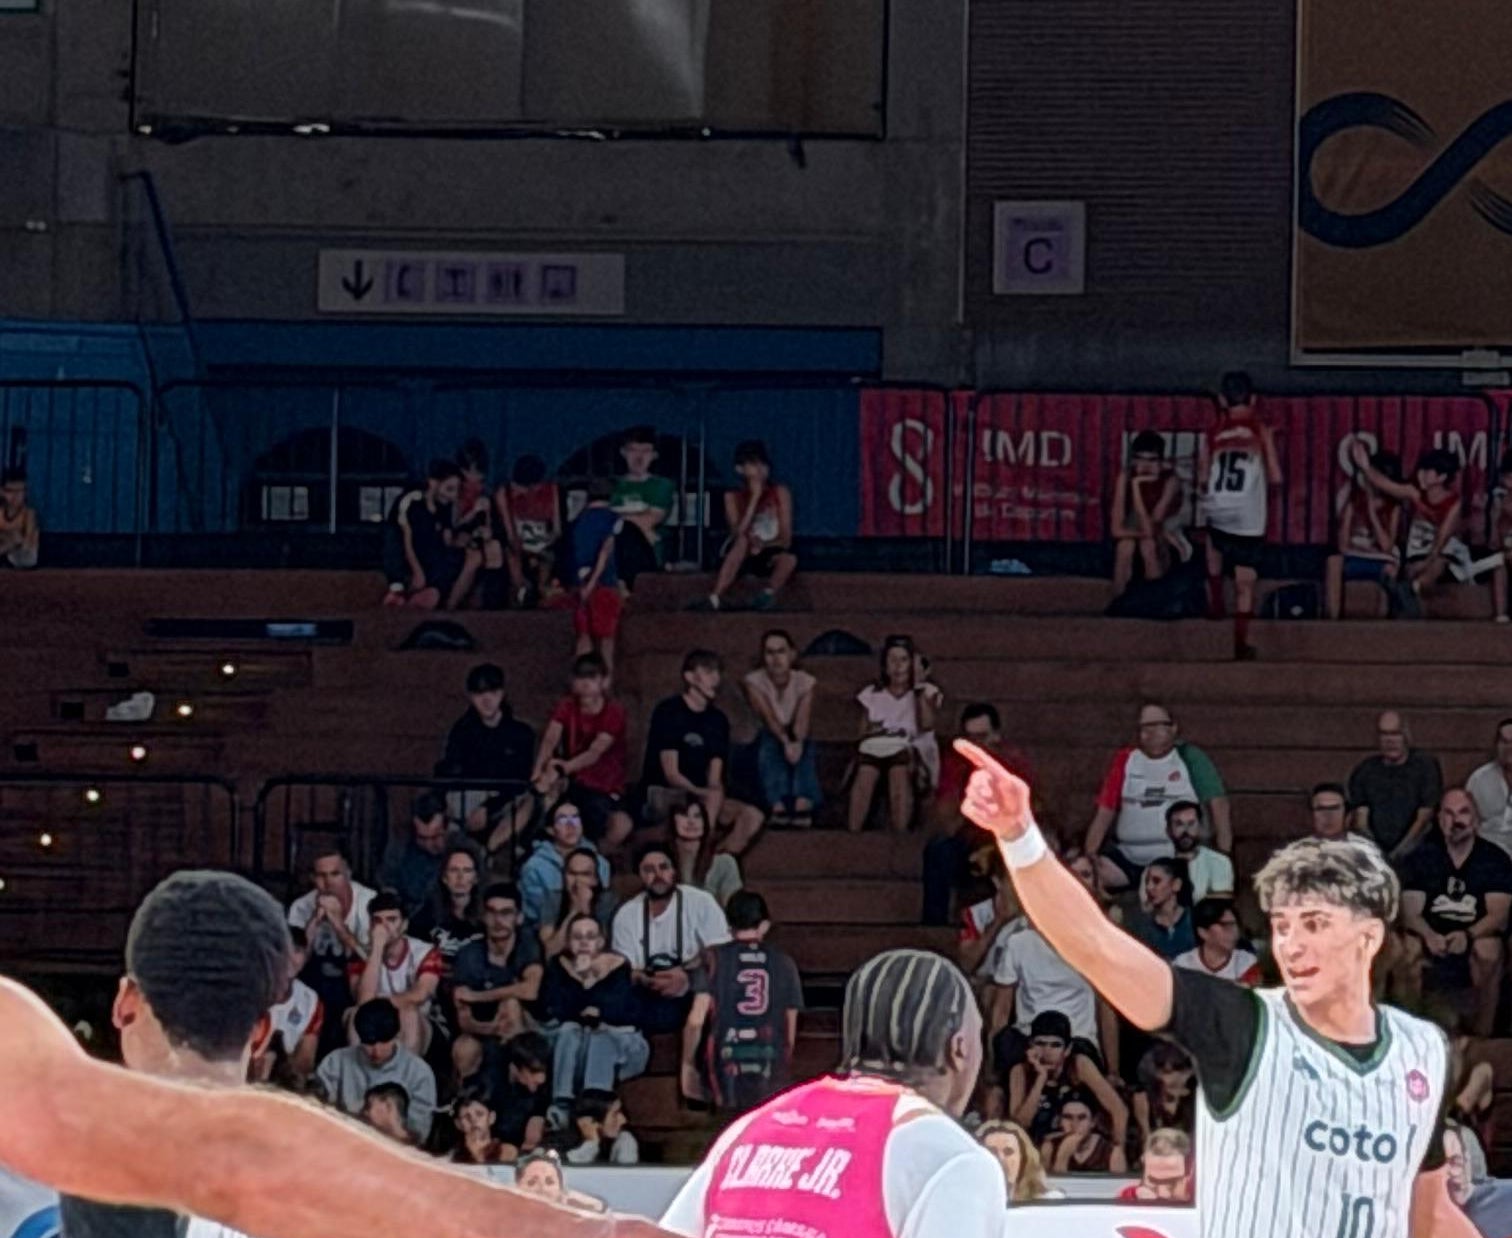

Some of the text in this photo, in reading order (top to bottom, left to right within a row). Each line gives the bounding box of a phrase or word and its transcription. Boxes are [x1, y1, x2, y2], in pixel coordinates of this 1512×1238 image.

[1024, 237, 1053, 274] C
[1215, 451, 1246, 492] 15
[735, 967, 770, 1016] 3
[1304, 1119, 1398, 1164] coto
